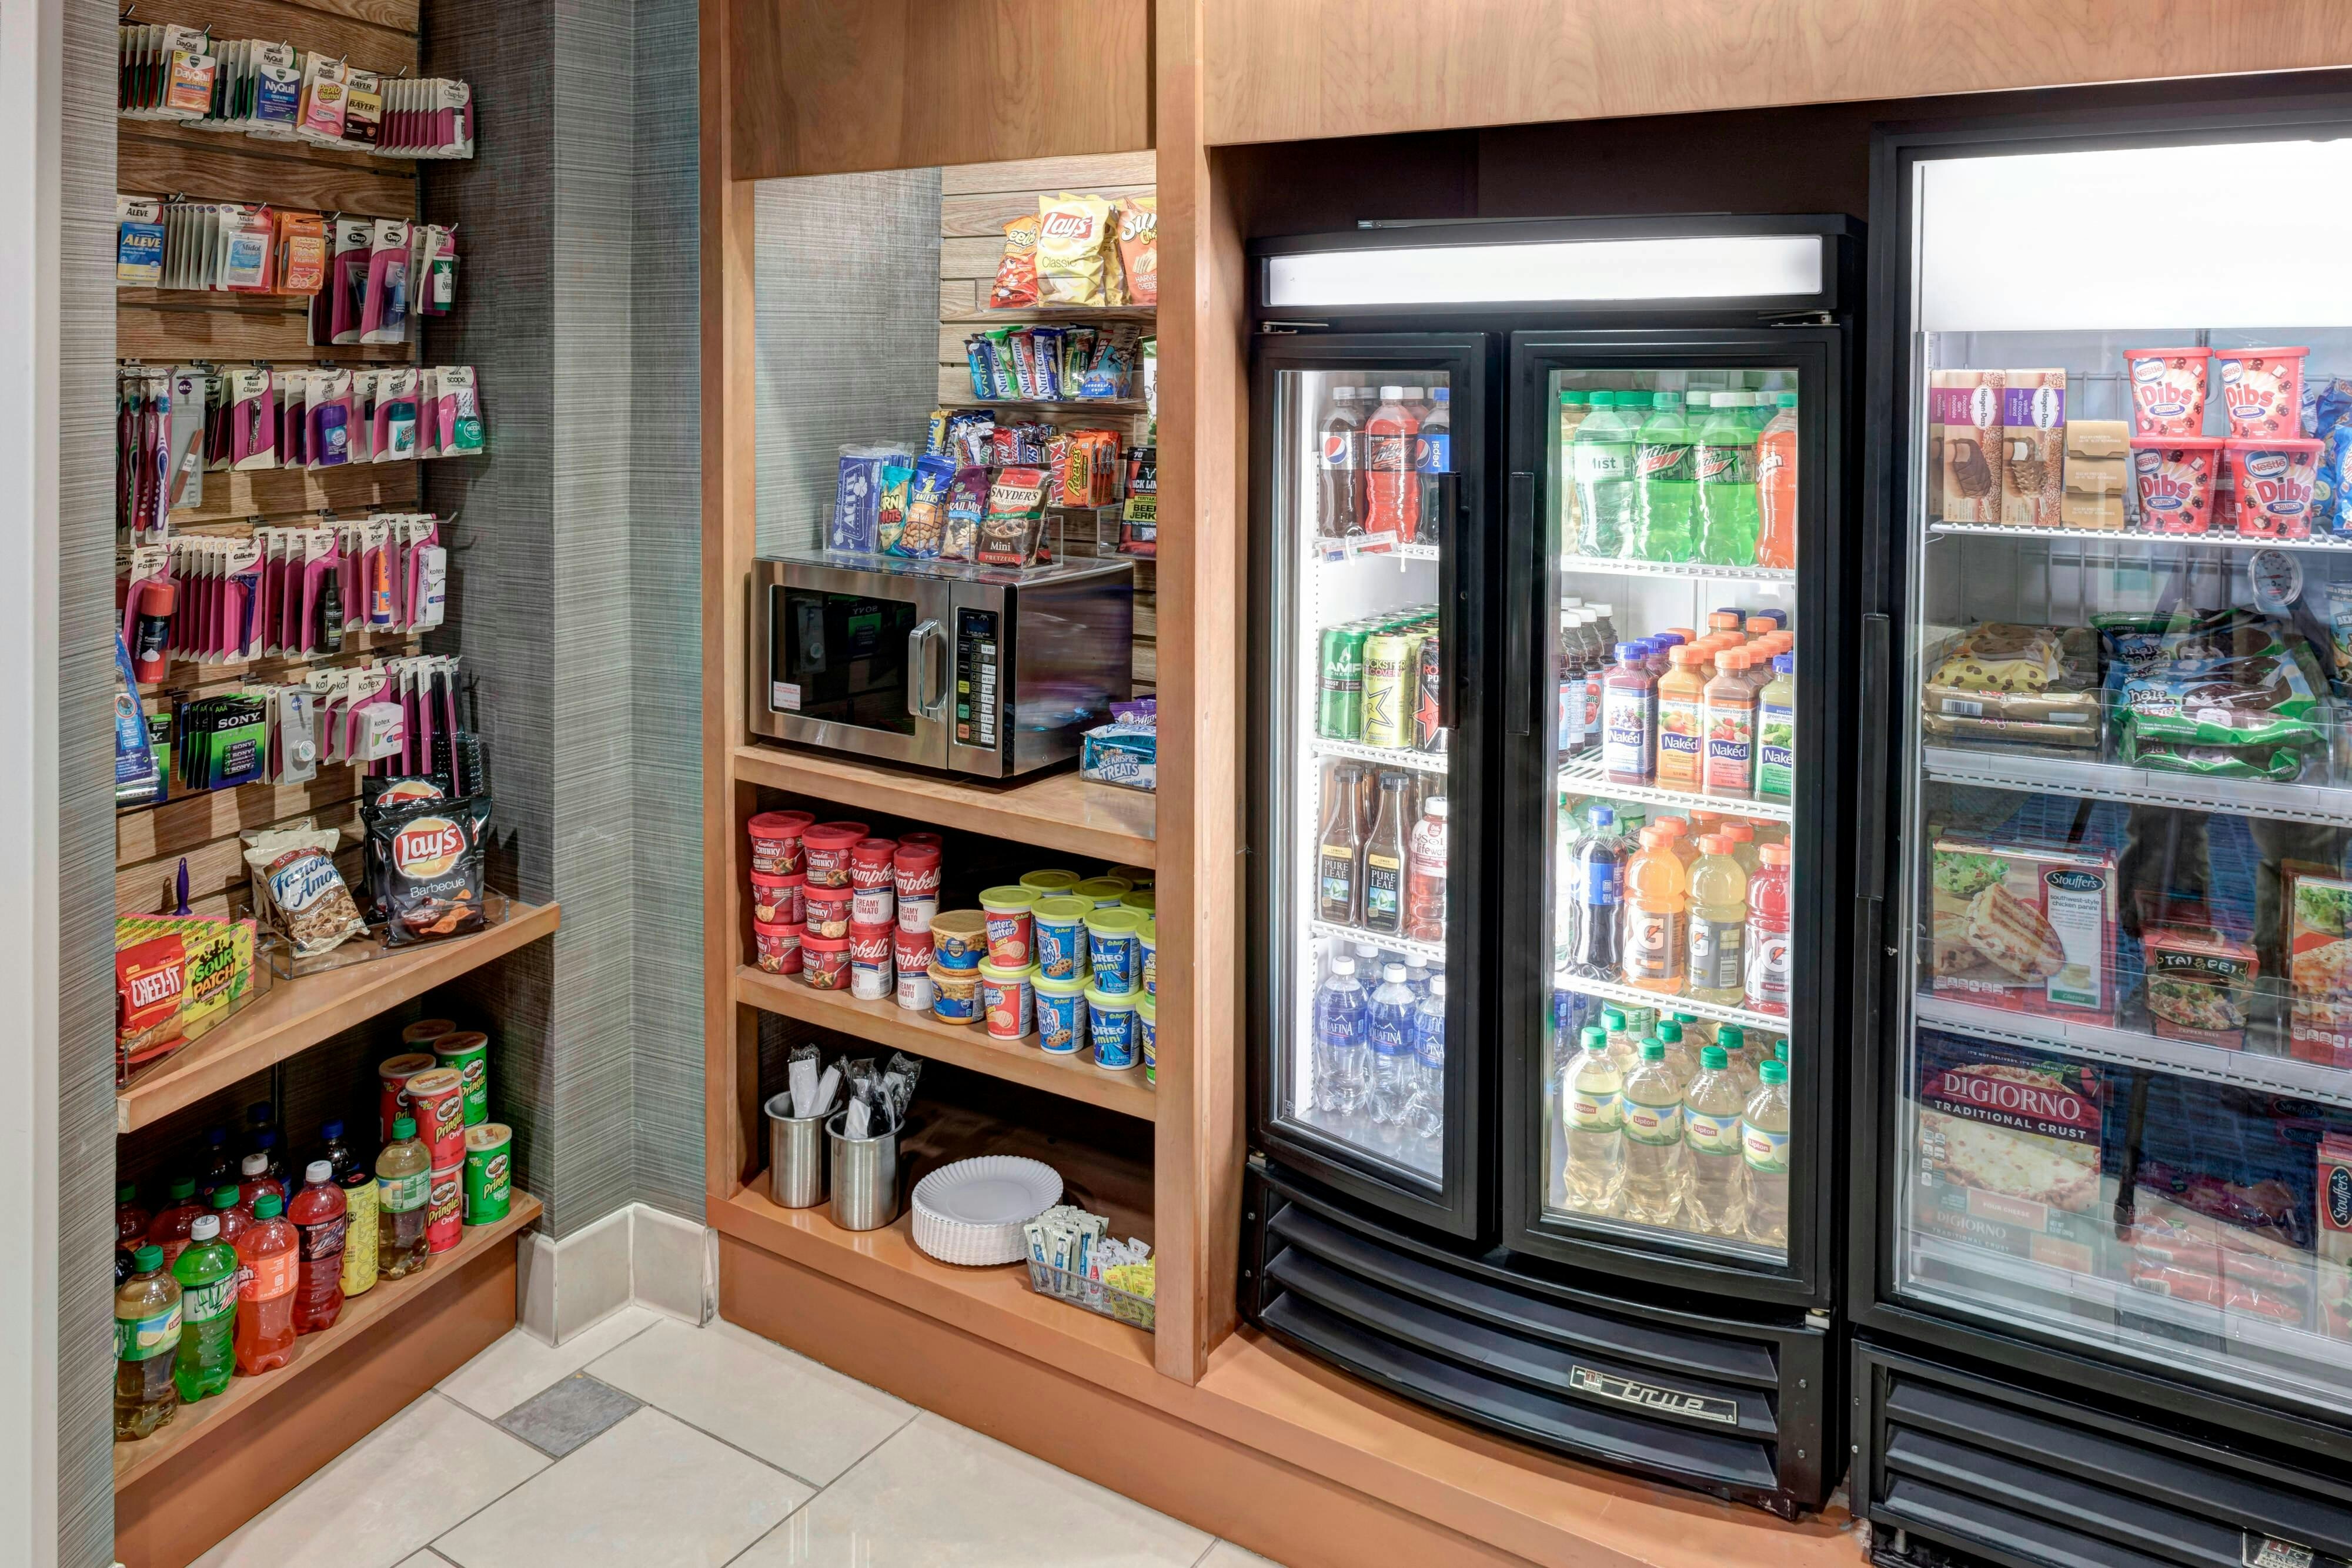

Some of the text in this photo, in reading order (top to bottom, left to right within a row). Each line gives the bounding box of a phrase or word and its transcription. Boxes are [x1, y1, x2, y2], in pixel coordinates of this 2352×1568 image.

[176, 40, 197, 49] DayQuil
[264, 54, 283, 63] NyQuil
[175, 68, 210, 81] DayQuil
[265, 81, 295, 93] NyQuil
[318, 84, 342, 94] Pepto-
[350, 81, 372, 89] BAYER
[349, 101, 374, 111] BAYER
[126, 208, 148, 217] ALEVE
[1041, 212, 1093, 239] Lay's
[123, 235, 161, 248] ALEVE
[1042, 256, 1077, 269] Classic
[1014, 341, 1032, 394] Nutri Grain
[977, 355, 990, 395] LUNA
[1039, 369, 1048, 394] Nutri
[2140, 381, 2193, 406] Dibs
[2225, 383, 2275, 407] Dibs
[2236, 407, 2259, 415] CRUNCH
[1432, 440, 1441, 467] pepsi
[1049, 442, 1066, 502] TWIX
[1066, 447, 1081, 497] Reese's
[2139, 473, 2193, 499] Dibs
[2255, 477, 2311, 503] Dibs
[991, 487, 1038, 501] SNYDER'S
[2151, 499, 2176, 507] CRUNCH
[844, 497, 857, 530] ACT
[879, 509, 902, 524] NUTS
[990, 541, 1010, 550] Mini
[1325, 661, 1362, 672] AMP
[2129, 690, 2167, 703] half
[374, 718, 390, 727] kotex
[1609, 730, 1641, 744] Naked
[1665, 737, 1699, 750] Naked
[1712, 744, 1747, 757] Naked
[1765, 750, 1793, 764] Nake
[231, 764, 251, 772] SONY
[1099, 755, 1138, 769] RICE KRISPIES
[1099, 763, 1139, 781] TREATS
[401, 827, 457, 866] Lay's
[756, 845, 781, 857] CHUNKY
[809, 858, 835, 868] CHUNKY
[1324, 860, 1349, 871] PURE
[269, 855, 333, 903] Famous
[1324, 868, 1346, 879] LEAF
[1371, 870, 1396, 882] PURE
[1371, 880, 1394, 890] LEAF
[2051, 873, 2097, 888] Stouffer's
[293, 868, 339, 907] Amos
[410, 877, 466, 898] Barbecue
[295, 891, 338, 921] Chocolate Chip
[856, 898, 879, 907] CREAMY
[2050, 895, 2099, 905] southwest-style
[2052, 901, 2077, 909] chicken
[856, 905, 878, 915] TOMATO
[987, 920, 1012, 932] Nutter
[990, 927, 1015, 941] Butter
[1636, 918, 1665, 950] G
[1091, 954, 1123, 962] OREO
[2165, 955, 2236, 974] TAI PEI
[195, 948, 233, 982] SOUR
[1096, 962, 1119, 971] mini
[131, 965, 180, 1008] CHEEZ-IT
[193, 964, 235, 1001] PATCH
[1092, 1027, 1125, 1035] OREO
[2178, 1027, 2203, 1035] PEPPER
[1097, 1035, 1121, 1044] mini
[1575, 1103, 1597, 1114] Lipton
[1635, 1116, 1657, 1126] Lipton
[1935, 1100, 2086, 1139] TRADITIONAL CRUST
[435, 1111, 463, 1144] Pringles
[1695, 1125, 1716, 1136] Lipton
[1749, 1138, 1769, 1152] Lipton
[483, 1169, 509, 1199] Pringles
[2332, 1174, 2348, 1221] Stouffer's
[427, 1197, 460, 1226] Pringles
[2004, 1206, 2030, 1218] CHEESE
[1932, 1226, 2010, 1252] TRADITIONAL CRUST
[1622, 1381, 1703, 1412] true
